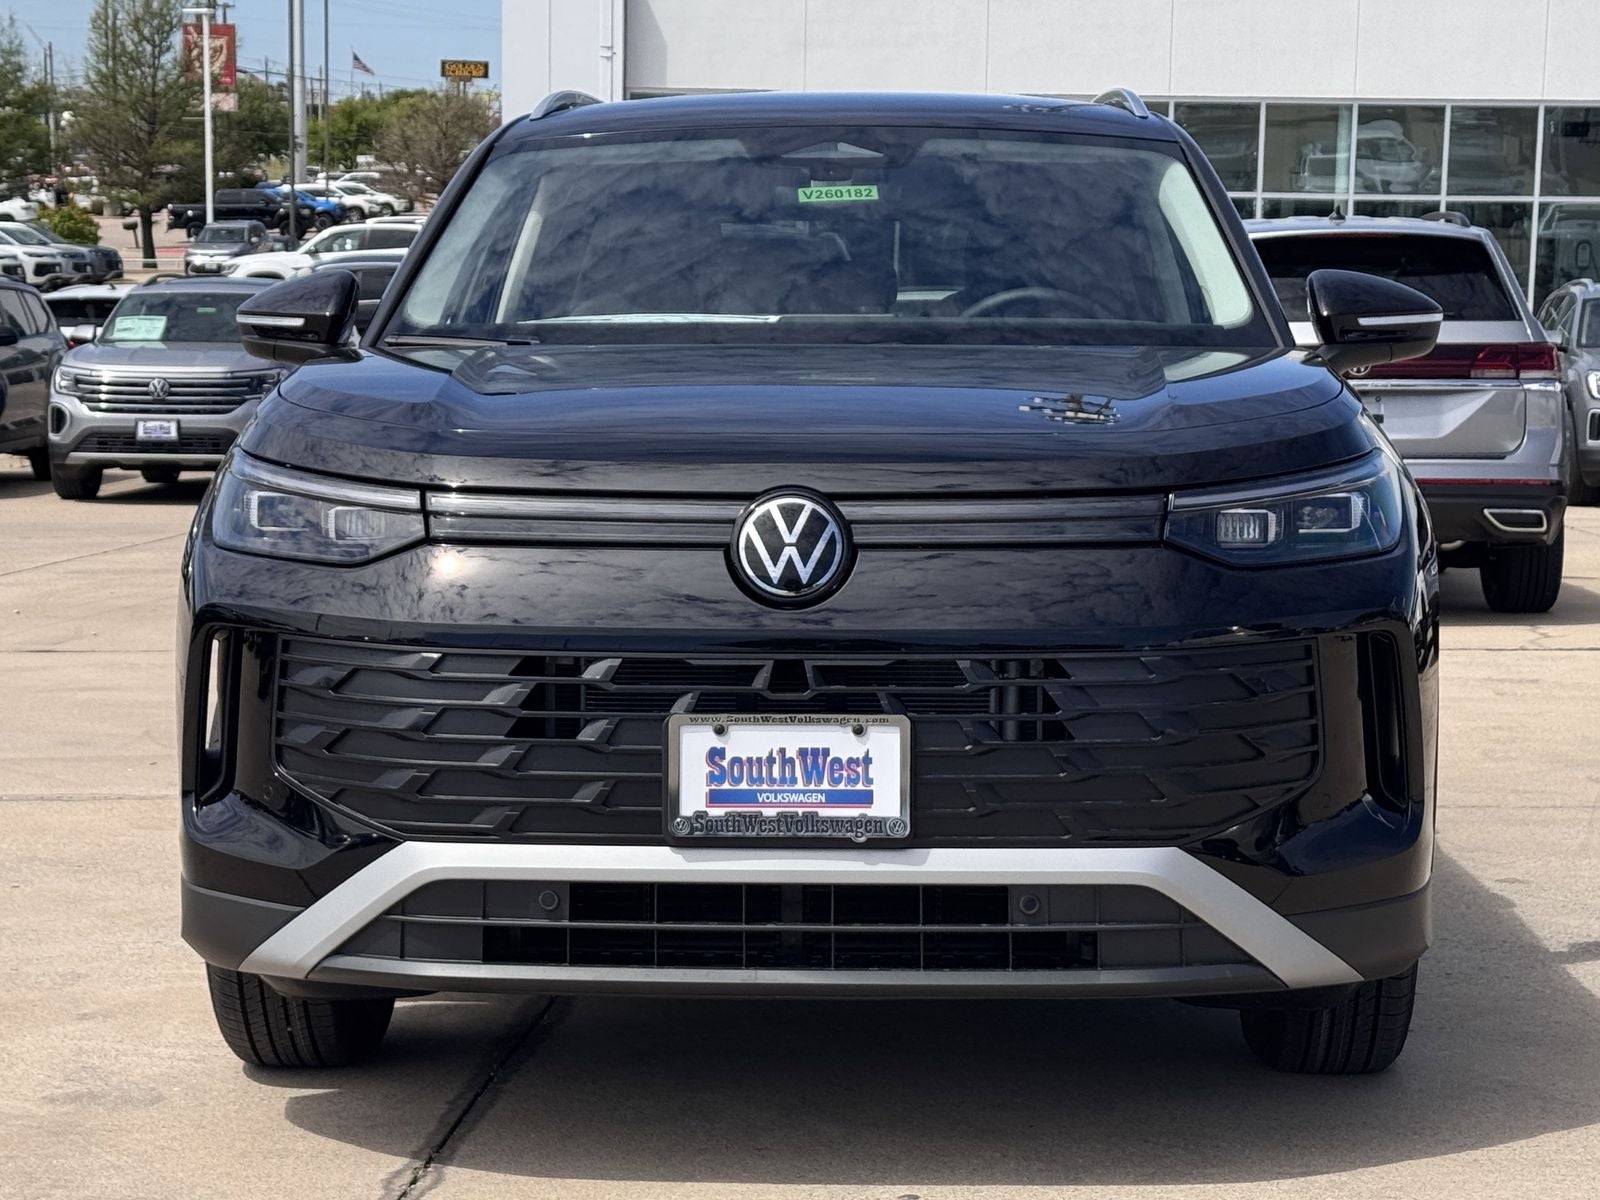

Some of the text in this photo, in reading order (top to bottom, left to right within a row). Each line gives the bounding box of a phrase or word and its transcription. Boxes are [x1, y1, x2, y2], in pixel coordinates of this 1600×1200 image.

[802, 188, 873, 199] V260182
[740, 499, 841, 593] VW
[757, 792, 826, 804] VOLKSWAGEN
